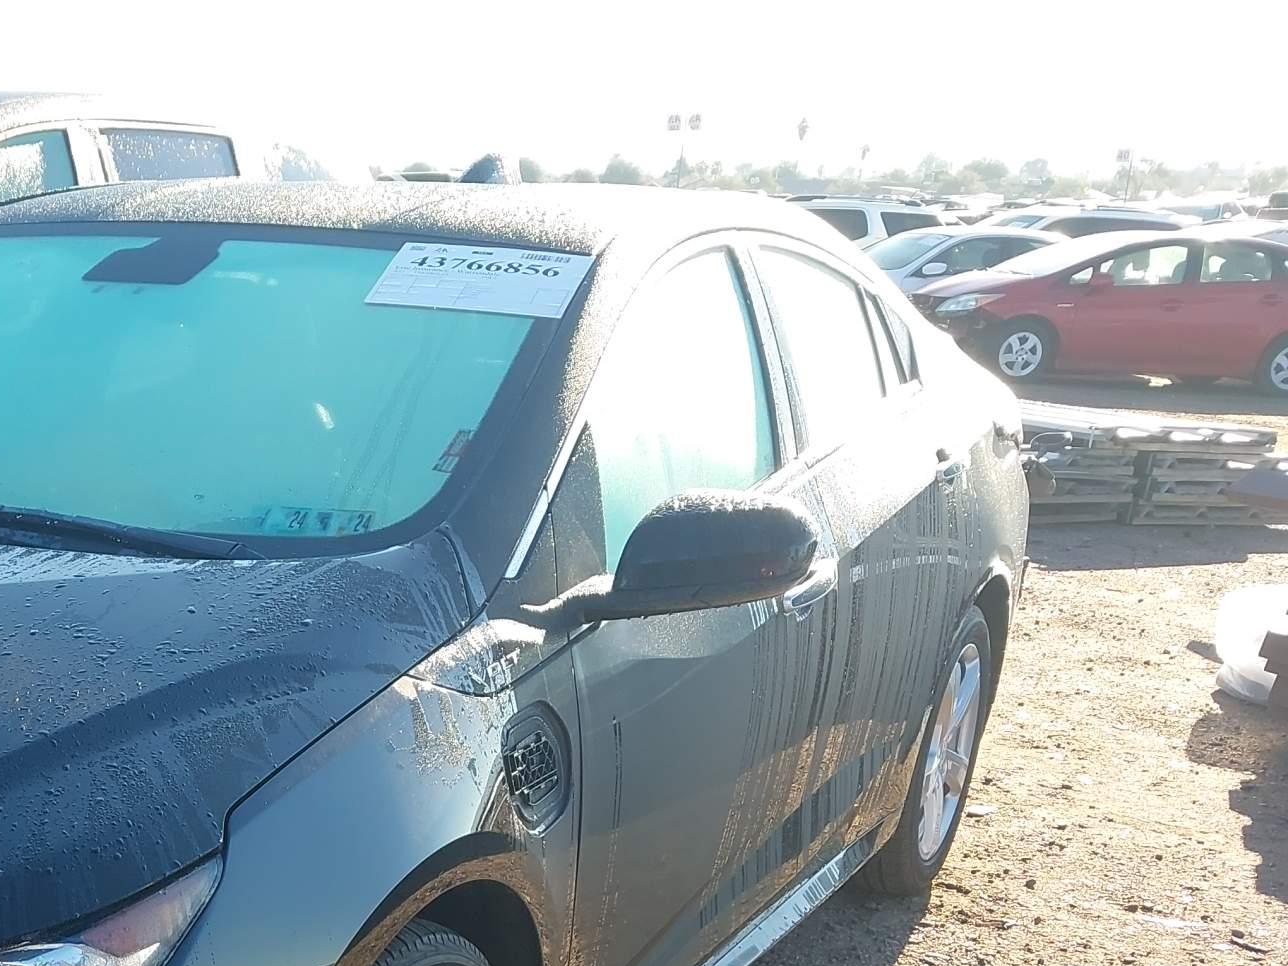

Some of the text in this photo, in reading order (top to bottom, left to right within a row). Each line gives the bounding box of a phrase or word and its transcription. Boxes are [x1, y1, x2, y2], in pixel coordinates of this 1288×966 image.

[410, 255, 561, 278] 43766856
[288, 511, 309, 529] 24
[353, 513, 372, 532] 24
